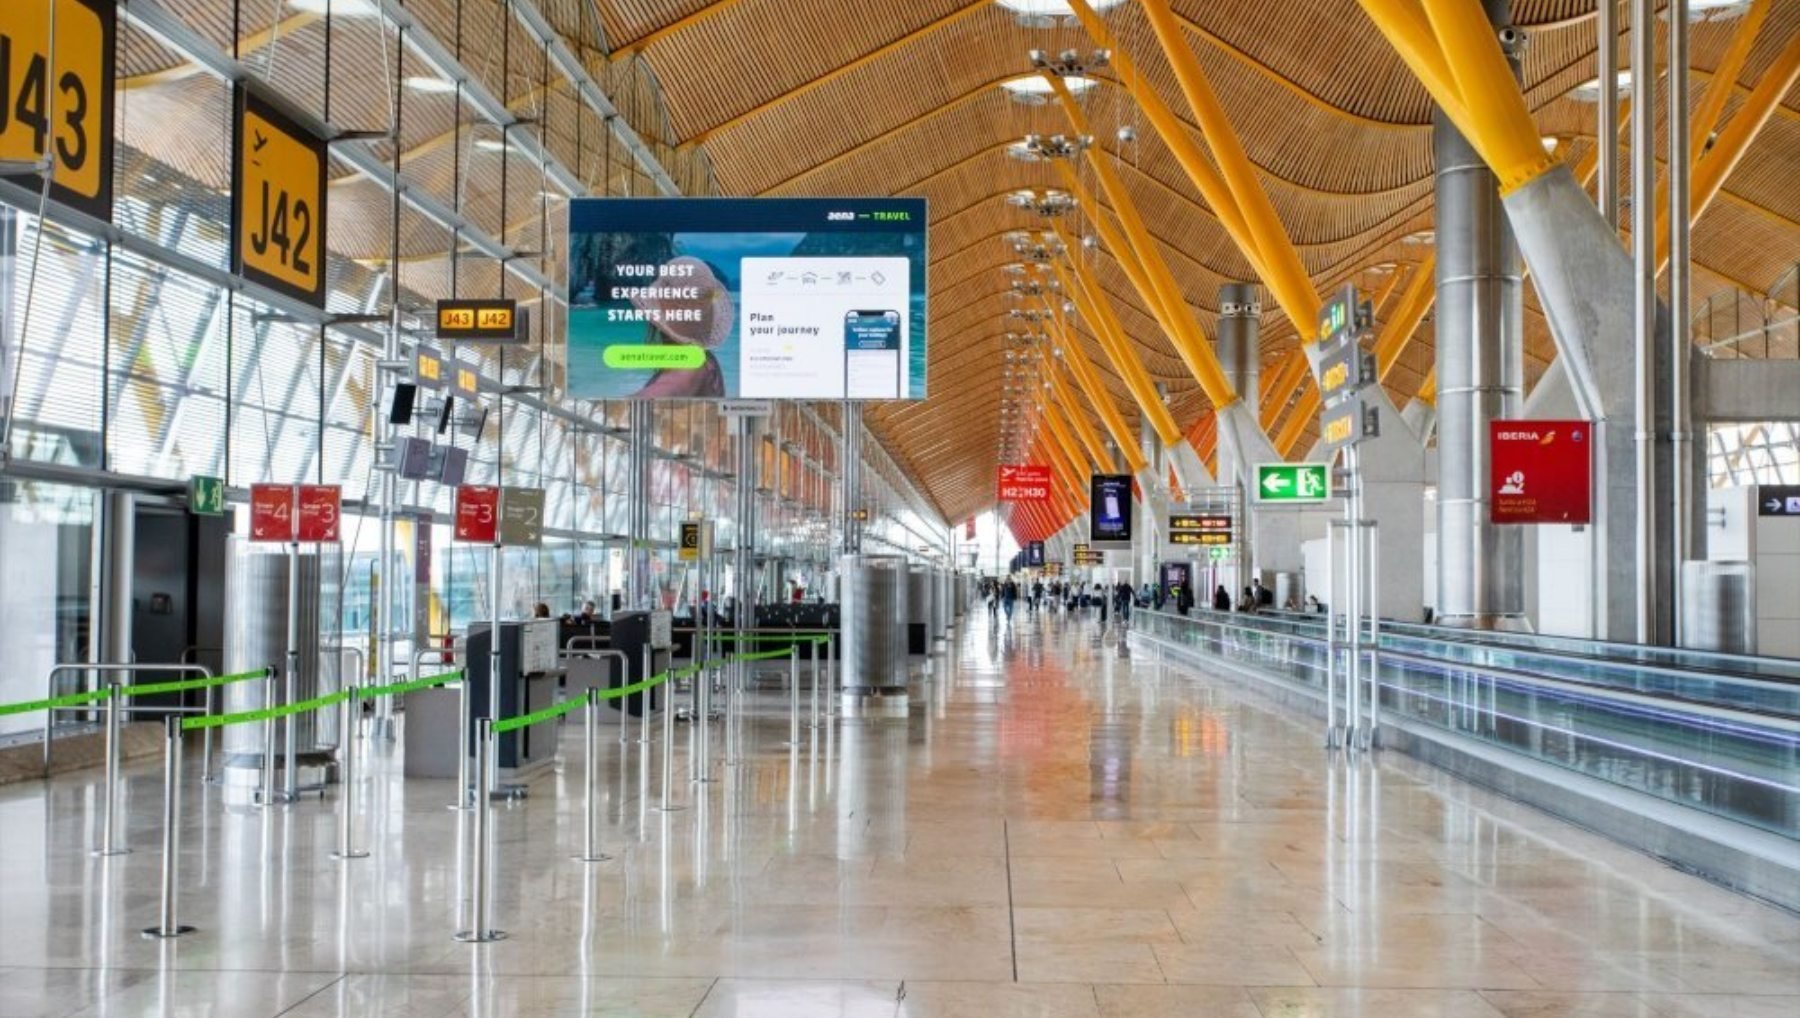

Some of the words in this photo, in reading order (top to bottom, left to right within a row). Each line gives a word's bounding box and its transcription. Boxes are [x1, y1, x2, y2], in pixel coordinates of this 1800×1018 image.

[827, 212, 855, 220] aena
[874, 212, 911, 220] TRAVEL
[251, 181, 311, 275] J42
[616, 264, 655, 277] YOUR
[660, 264, 695, 277] BEST
[611, 287, 699, 299] EXPERIENCE
[444, 313, 469, 325] J43
[482, 313, 508, 325] J42
[607, 309, 661, 321] STARTS
[665, 309, 702, 321] HERE
[750, 313, 775, 322] Plan
[750, 326, 774, 336] your
[777, 325, 820, 336] journey
[1497, 431, 1540, 441] IBERIA
[273, 502, 289, 521] 4
[321, 503, 335, 523] 3
[478, 504, 492, 523] 3
[524, 506, 538, 526] 2
